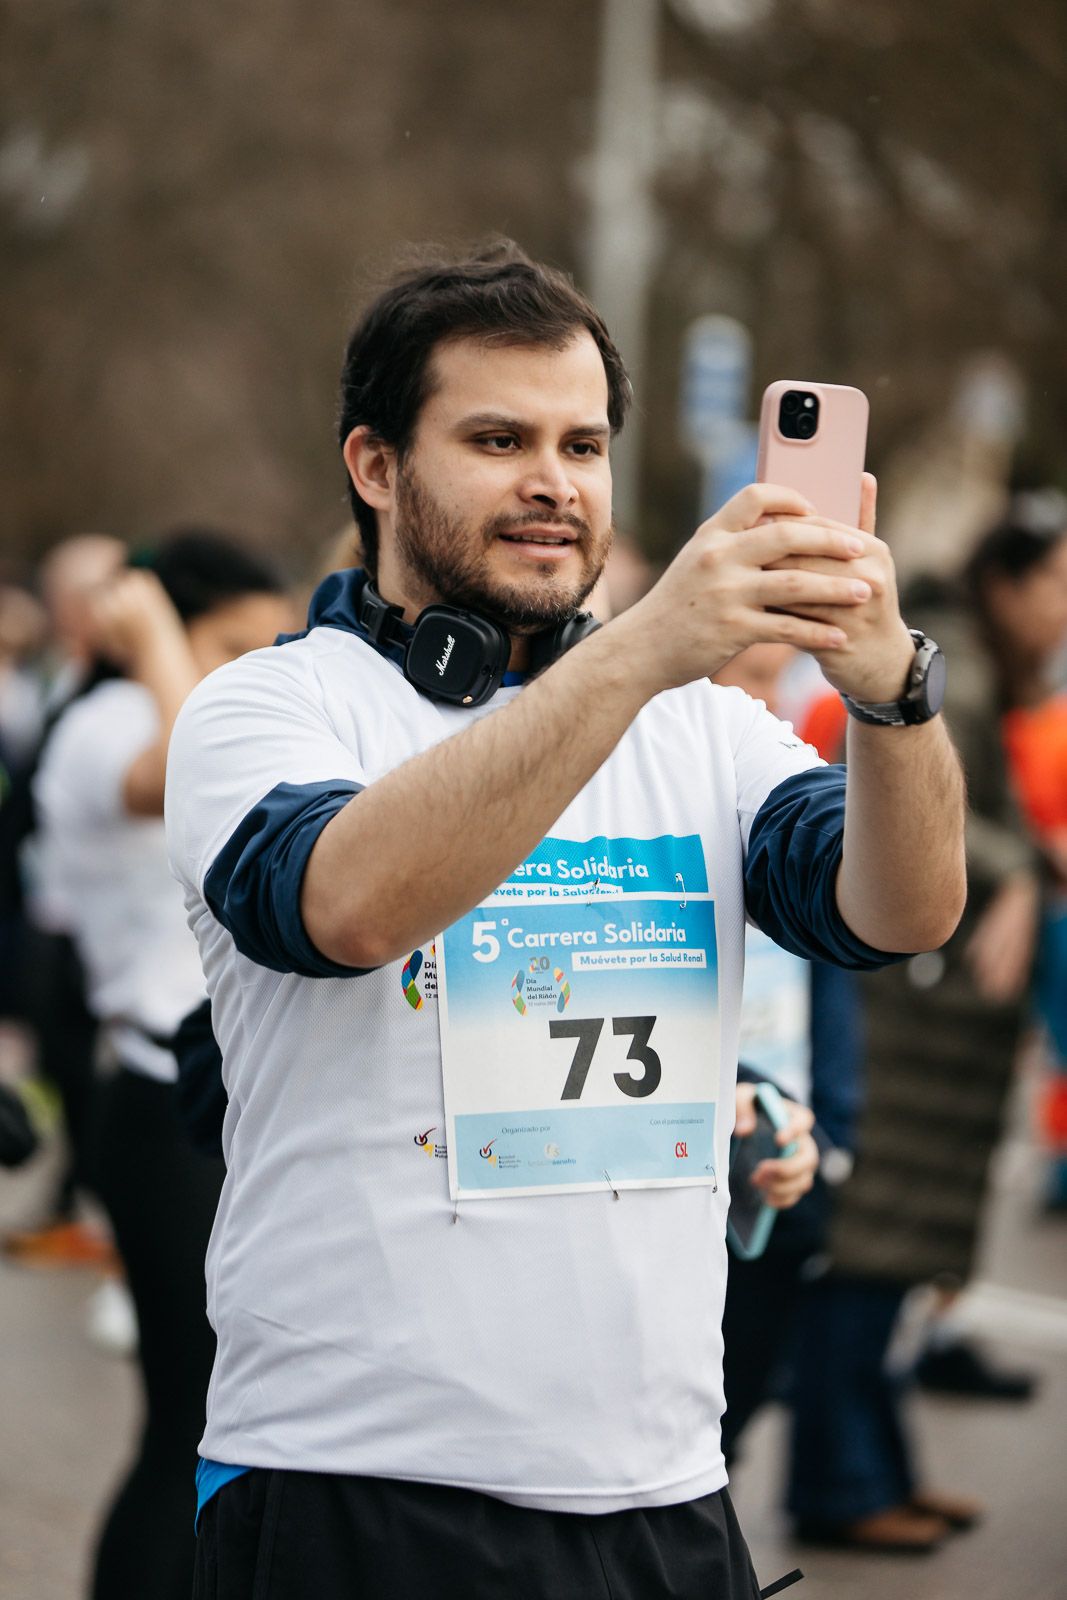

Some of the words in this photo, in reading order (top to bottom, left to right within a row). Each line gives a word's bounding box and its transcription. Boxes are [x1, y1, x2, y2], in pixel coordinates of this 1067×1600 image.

[434, 634, 456, 676] Marshall
[556, 856, 650, 879] Solidaria
[527, 889, 546, 898] por
[549, 887, 559, 897] la
[507, 927, 598, 949] Carrera
[604, 921, 687, 945] Solidaria
[580, 955, 627, 965] Muévete
[630, 956, 646, 966] por
[649, 953, 658, 962] la
[660, 952, 682, 962] Salud
[683, 953, 703, 962] Renal
[538, 992, 557, 1000] Riñón
[548, 1015, 662, 1101] 73
[501, 1126, 539, 1135] Organizado
[675, 1141, 688, 1158] CSL
